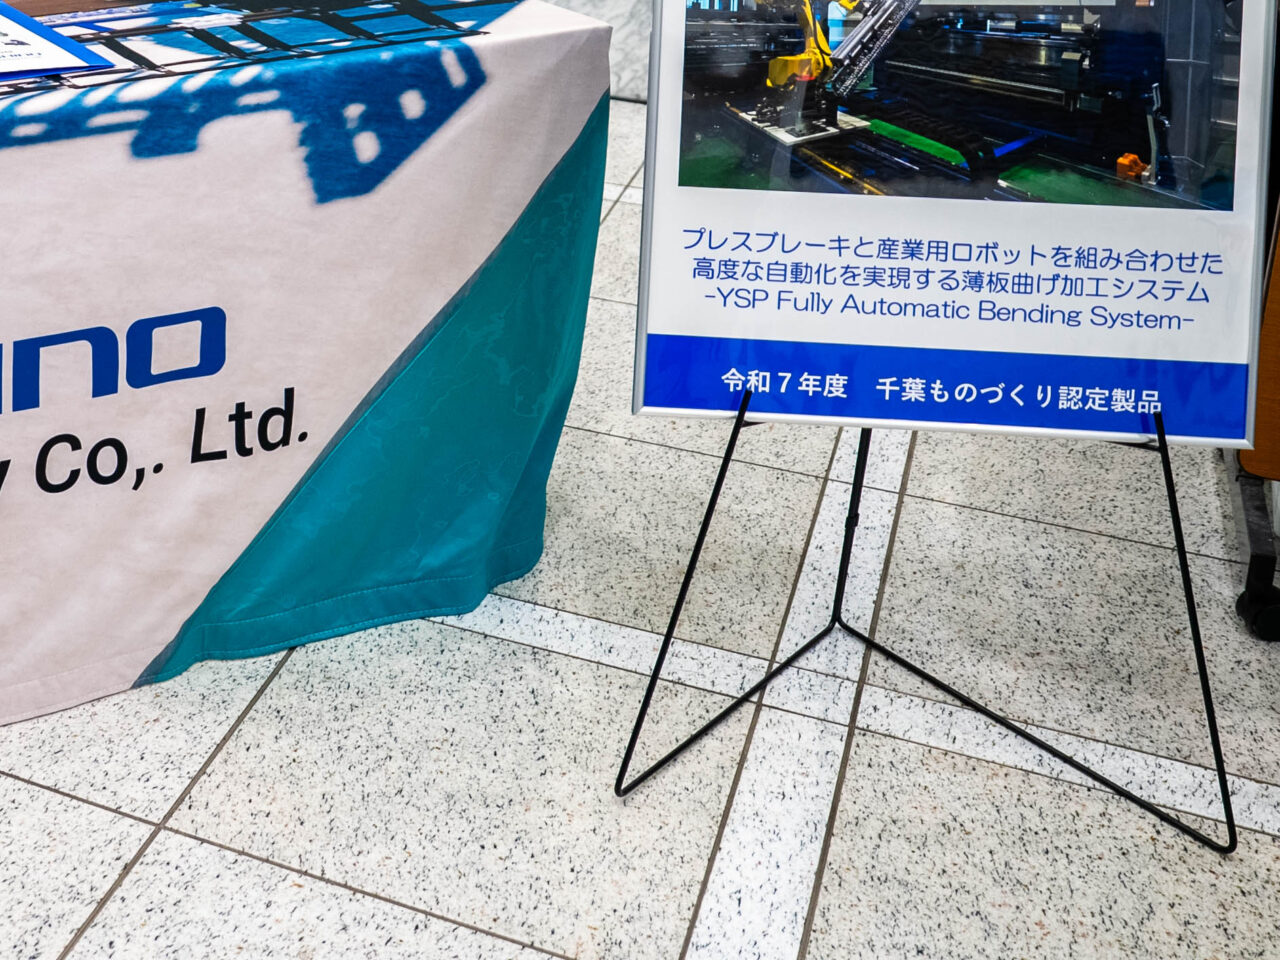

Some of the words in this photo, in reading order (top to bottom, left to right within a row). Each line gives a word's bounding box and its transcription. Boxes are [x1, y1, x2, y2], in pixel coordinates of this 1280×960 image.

[683, 226, 1224, 275] プレスブレーキと産業用ロボットを組み合わせた
[692, 256, 1210, 304] 高度な自動化を実現する薄板曲げ加工システム
[776, 290, 833, 315] Fully
[840, 293, 970, 320] Automatic
[978, 300, 1082, 327] Bending
[875, 376, 1163, 414] 千葉ものづくり認定製品
[190, 386, 309, 465] Ltd.
